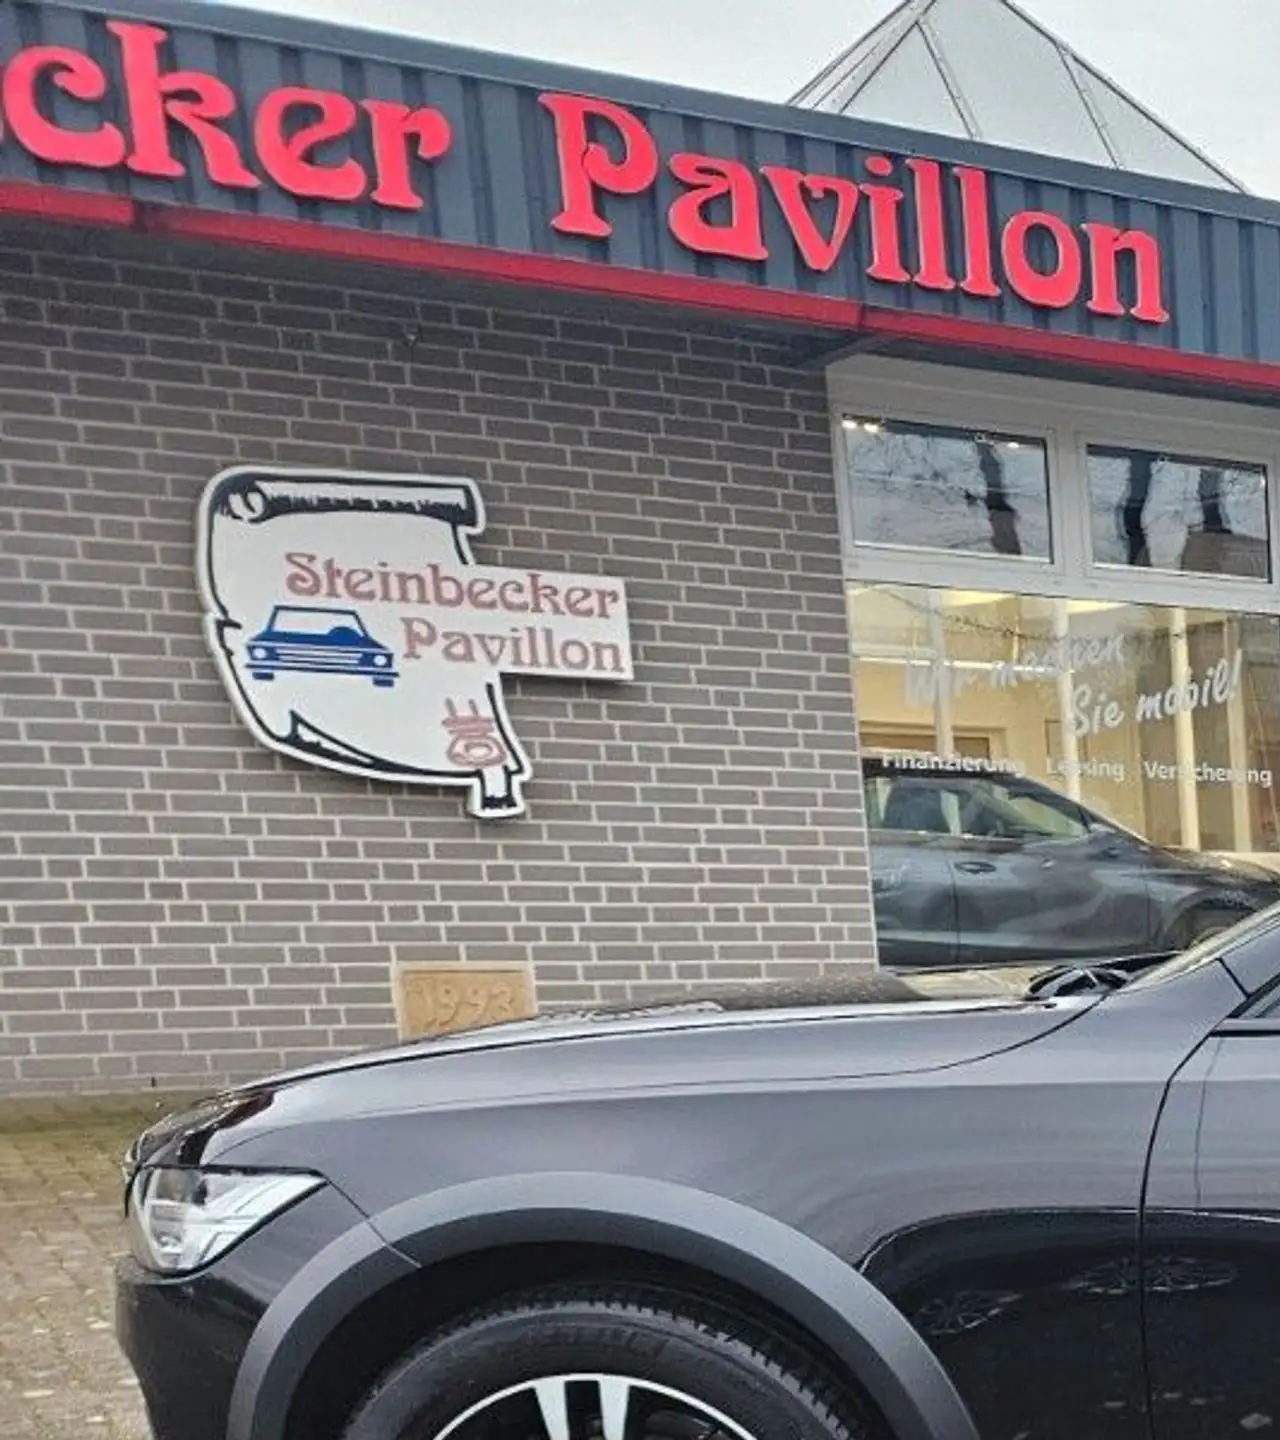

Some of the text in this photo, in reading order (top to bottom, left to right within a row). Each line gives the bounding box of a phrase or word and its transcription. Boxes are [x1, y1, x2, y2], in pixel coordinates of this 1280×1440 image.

[0, 21, 1170, 323] cker Pavillon
[284, 552, 622, 619] Steinbecker
[399, 616, 626, 673] Pavillon
[1068, 648, 1243, 737] Sie mobil!
[881, 752, 1026, 779] Finanzierung
[1142, 760, 1274, 788] Versicherung
